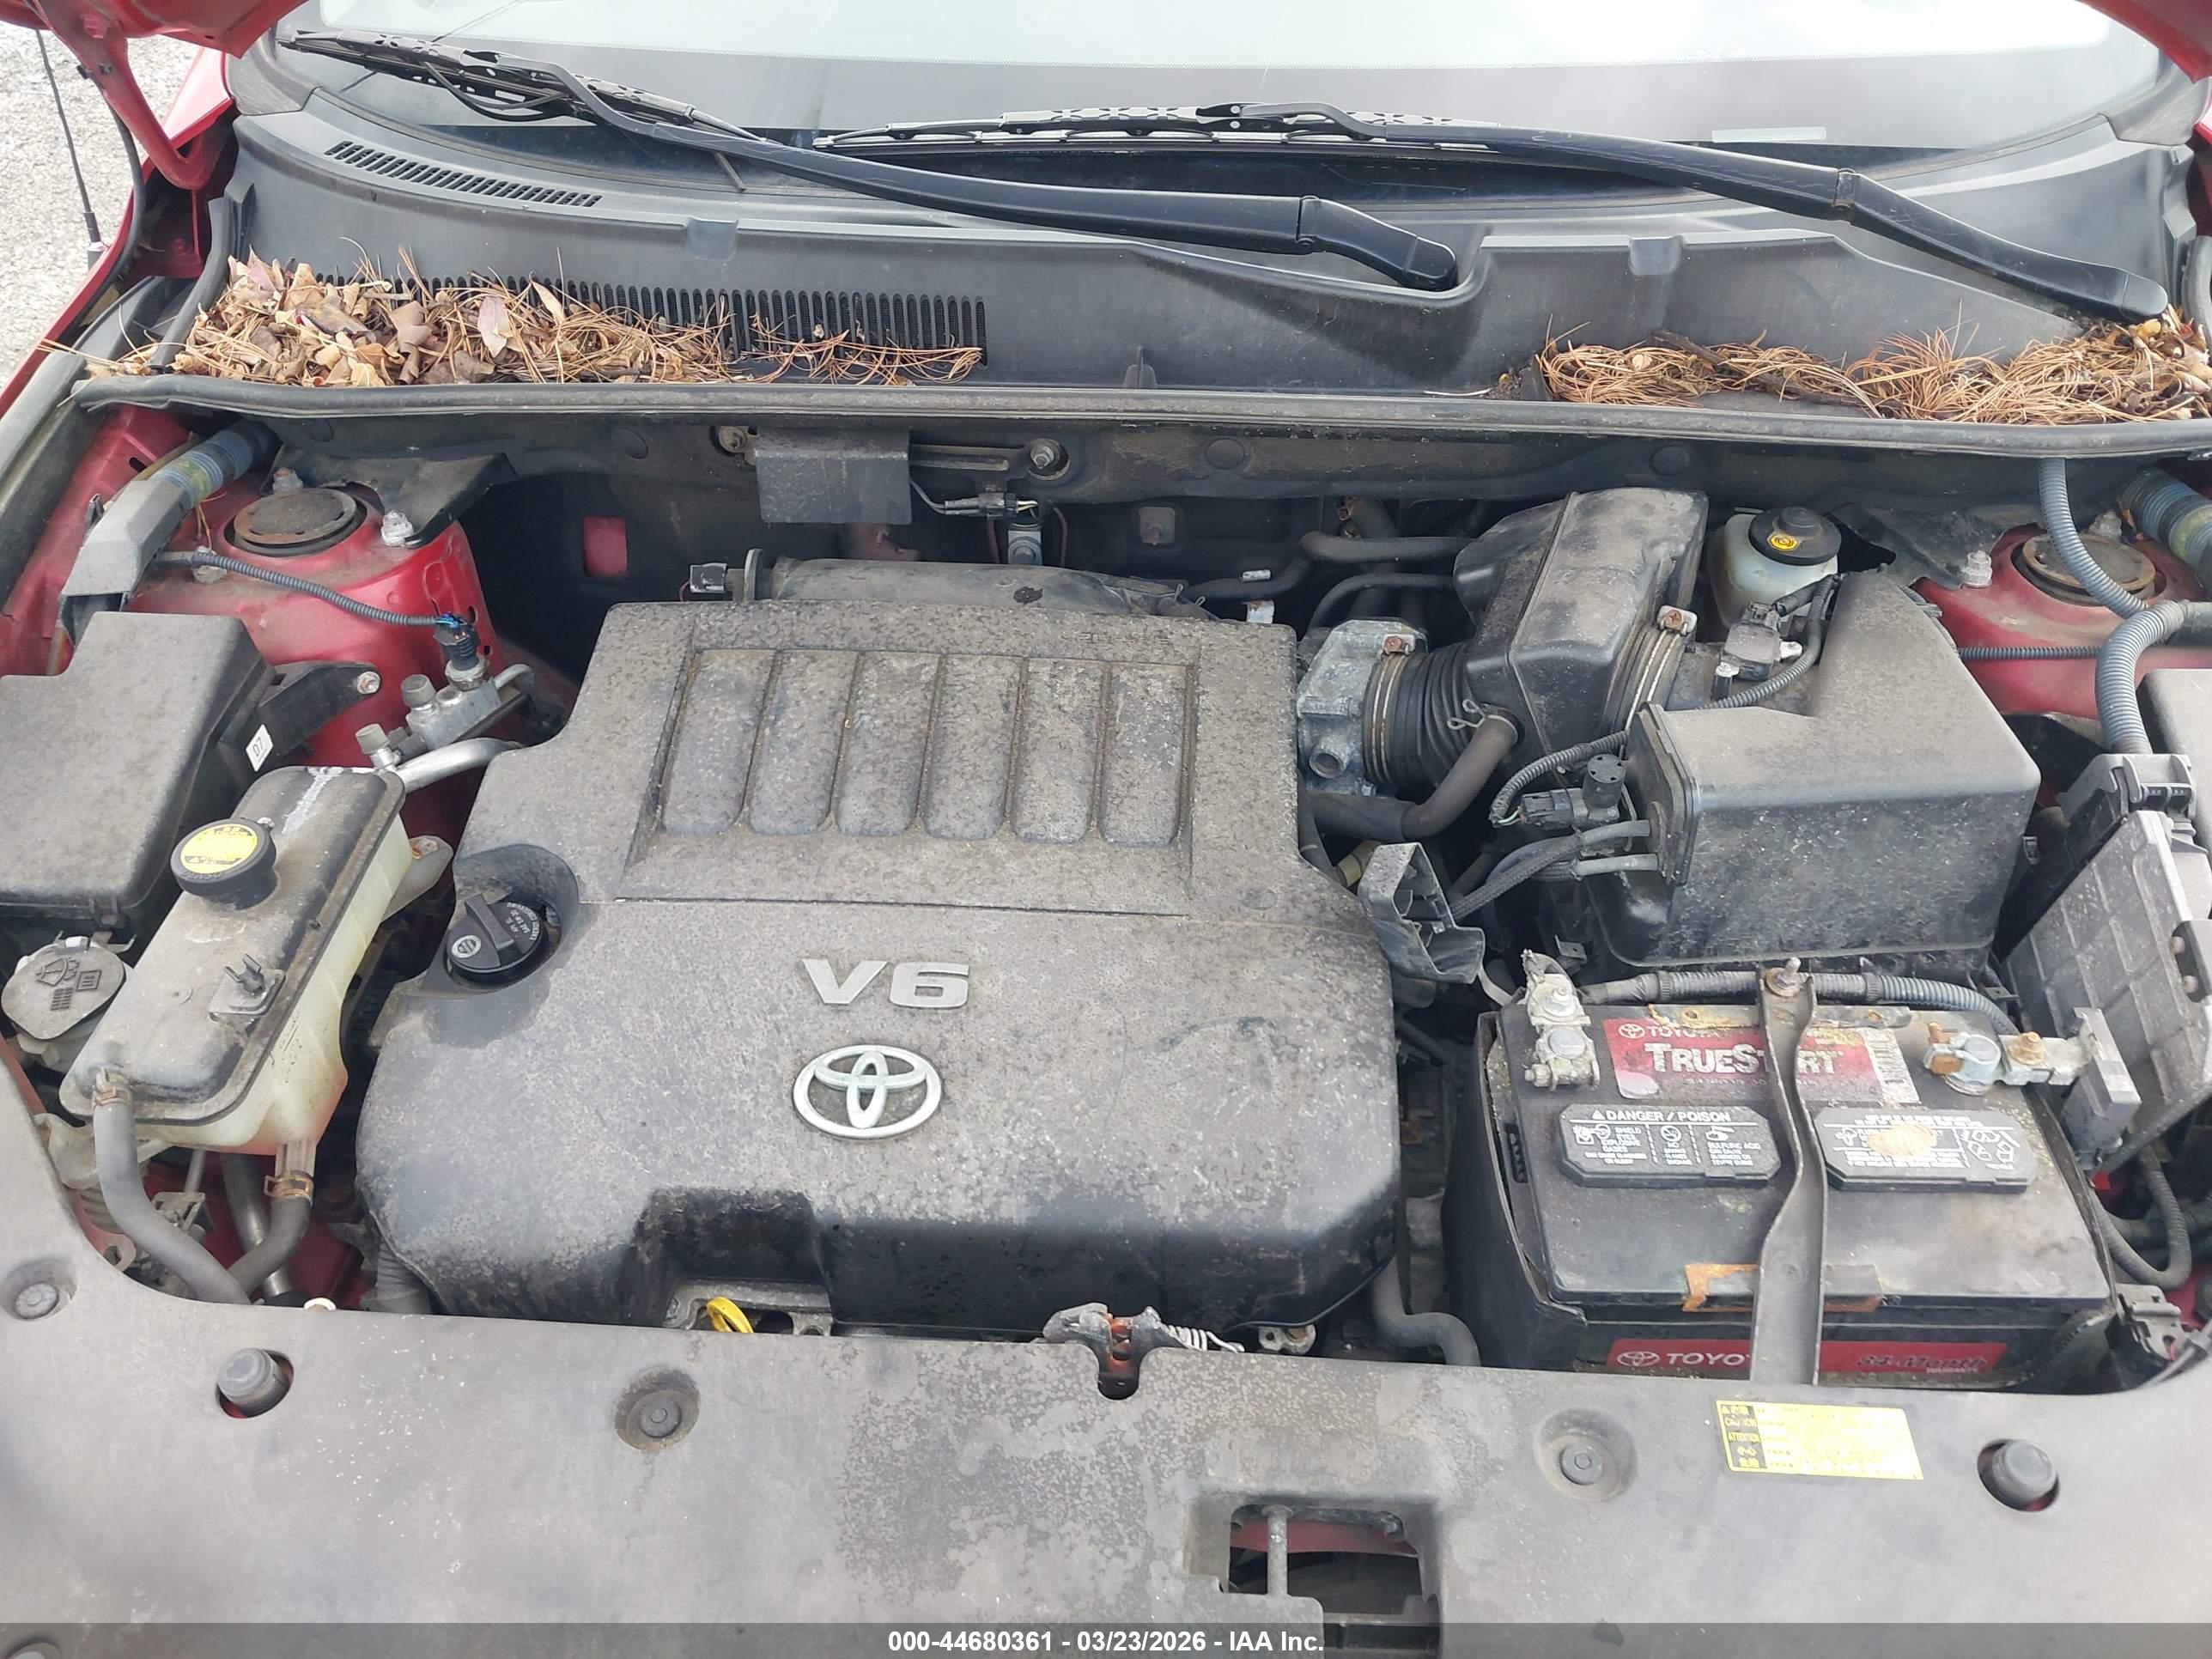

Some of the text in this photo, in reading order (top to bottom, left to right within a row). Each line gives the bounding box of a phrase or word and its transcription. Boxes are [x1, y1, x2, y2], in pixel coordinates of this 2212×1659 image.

[802, 958, 969, 1008] V6
[1607, 1110, 1664, 1121] DANGER
[1677, 1111, 1731, 1122] POISON
[1667, 1352, 1750, 1367] TOYO
